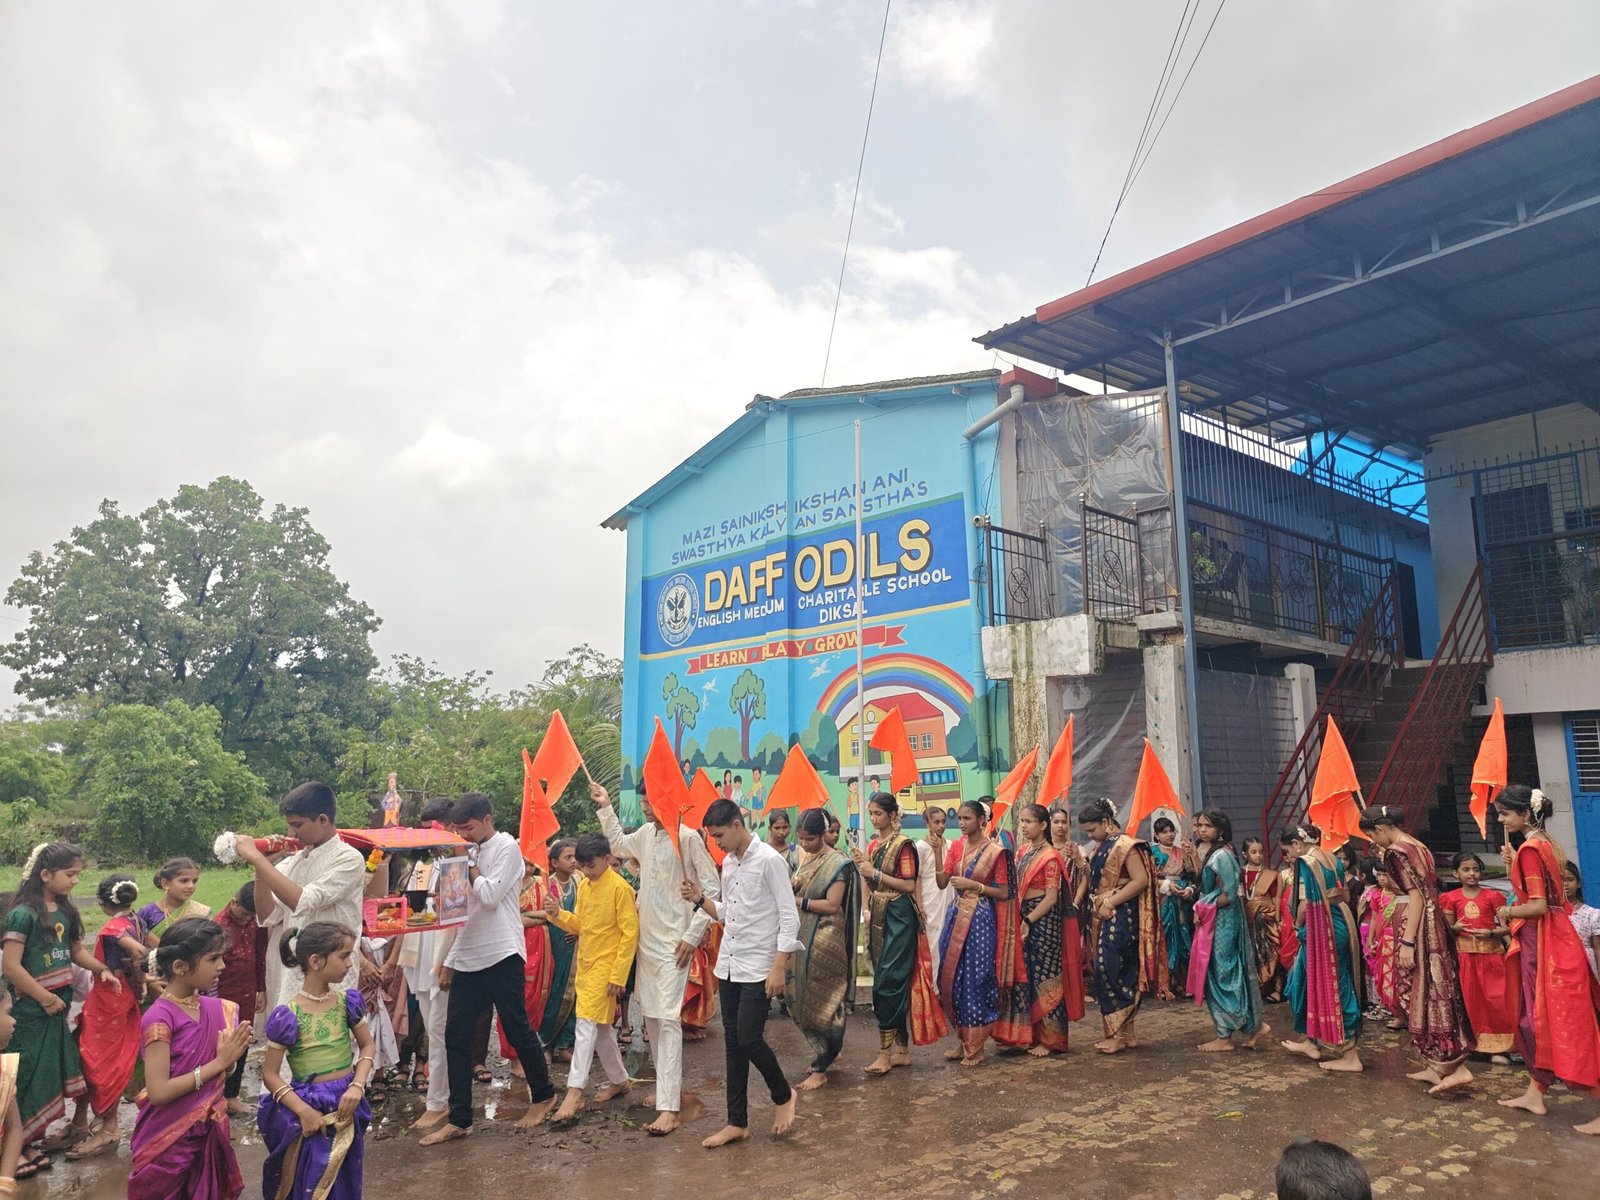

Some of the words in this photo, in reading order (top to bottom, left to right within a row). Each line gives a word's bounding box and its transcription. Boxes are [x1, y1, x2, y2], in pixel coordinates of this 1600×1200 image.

[682, 525, 716, 546] MAZI
[873, 467, 908, 491] ANI
[671, 533, 746, 566] SWASTHYA
[697, 609, 741, 629] ENGLISH
[887, 567, 952, 593] SCHOOL
[706, 650, 748, 668] LEARN
[814, 631, 858, 652] GROW
